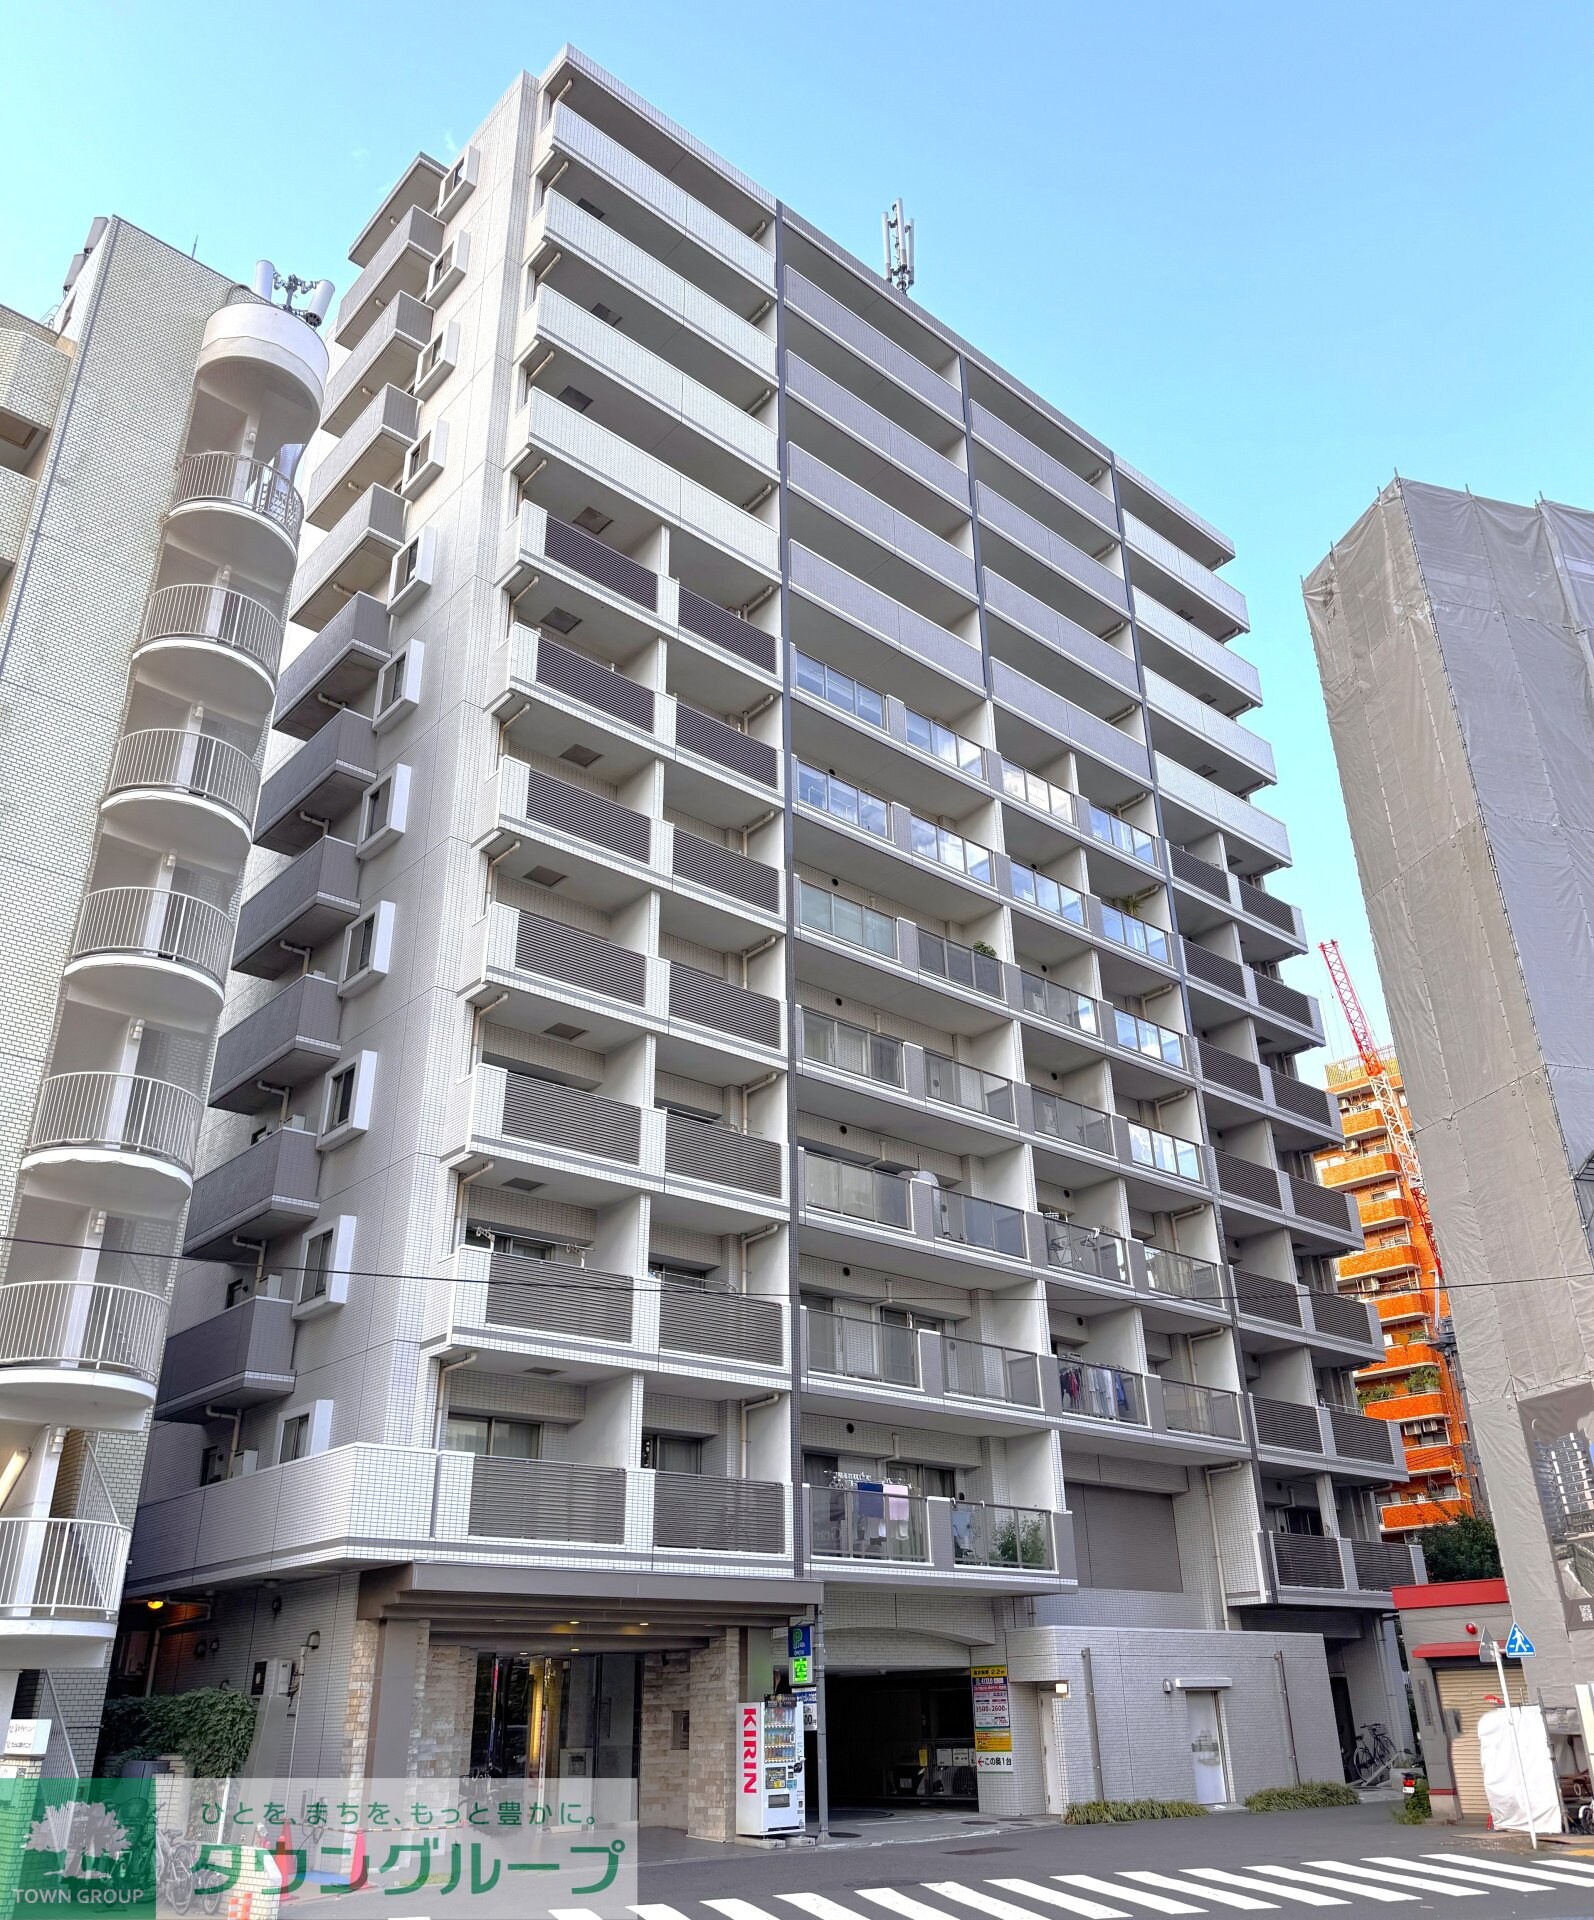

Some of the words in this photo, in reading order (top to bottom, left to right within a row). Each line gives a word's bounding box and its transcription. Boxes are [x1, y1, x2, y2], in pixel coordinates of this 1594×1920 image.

[793, 1629, 803, 1649] P
[793, 1658, 808, 1682] 空
[743, 1708, 757, 1793] KIRIN
